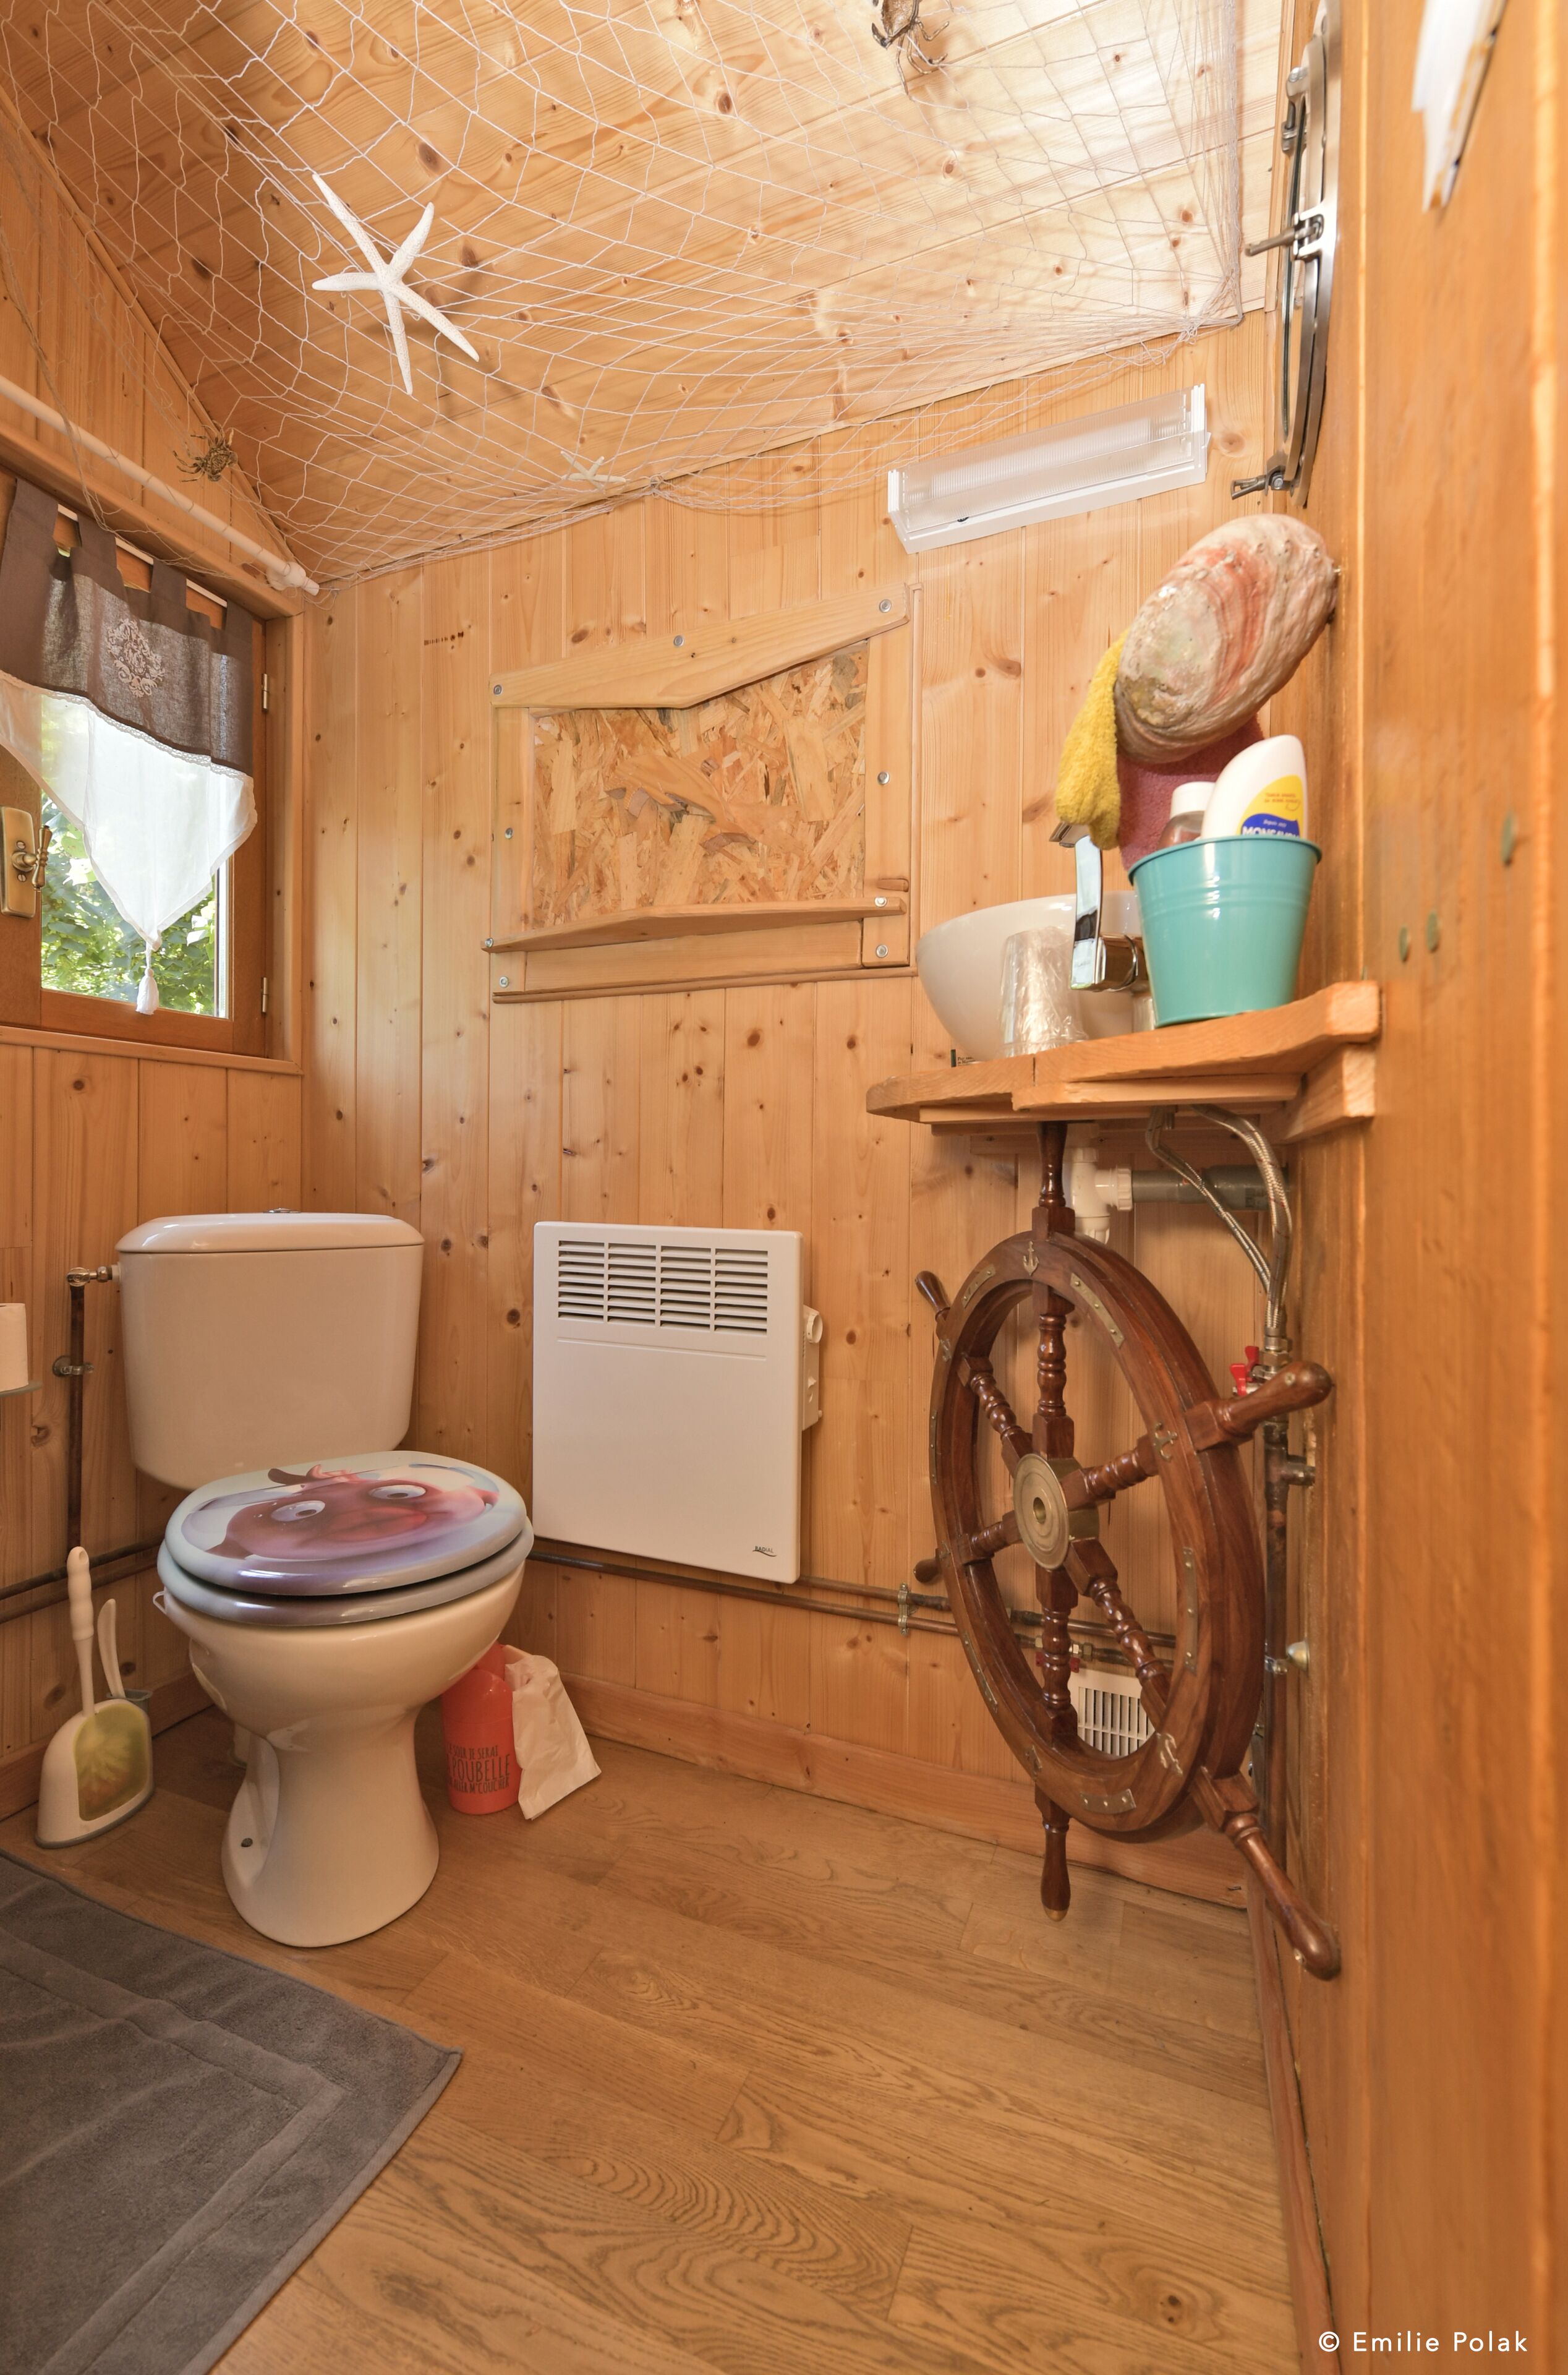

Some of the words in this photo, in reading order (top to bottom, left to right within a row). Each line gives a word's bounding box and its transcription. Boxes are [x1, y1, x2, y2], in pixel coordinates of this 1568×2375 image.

[1243, 826, 1299, 837] MONSA
[754, 1546, 774, 1554] RADIAL
[469, 1748, 476, 1760] JE
[477, 1745, 498, 1760] SERAI
[452, 1753, 510, 1782] POUBELLE
